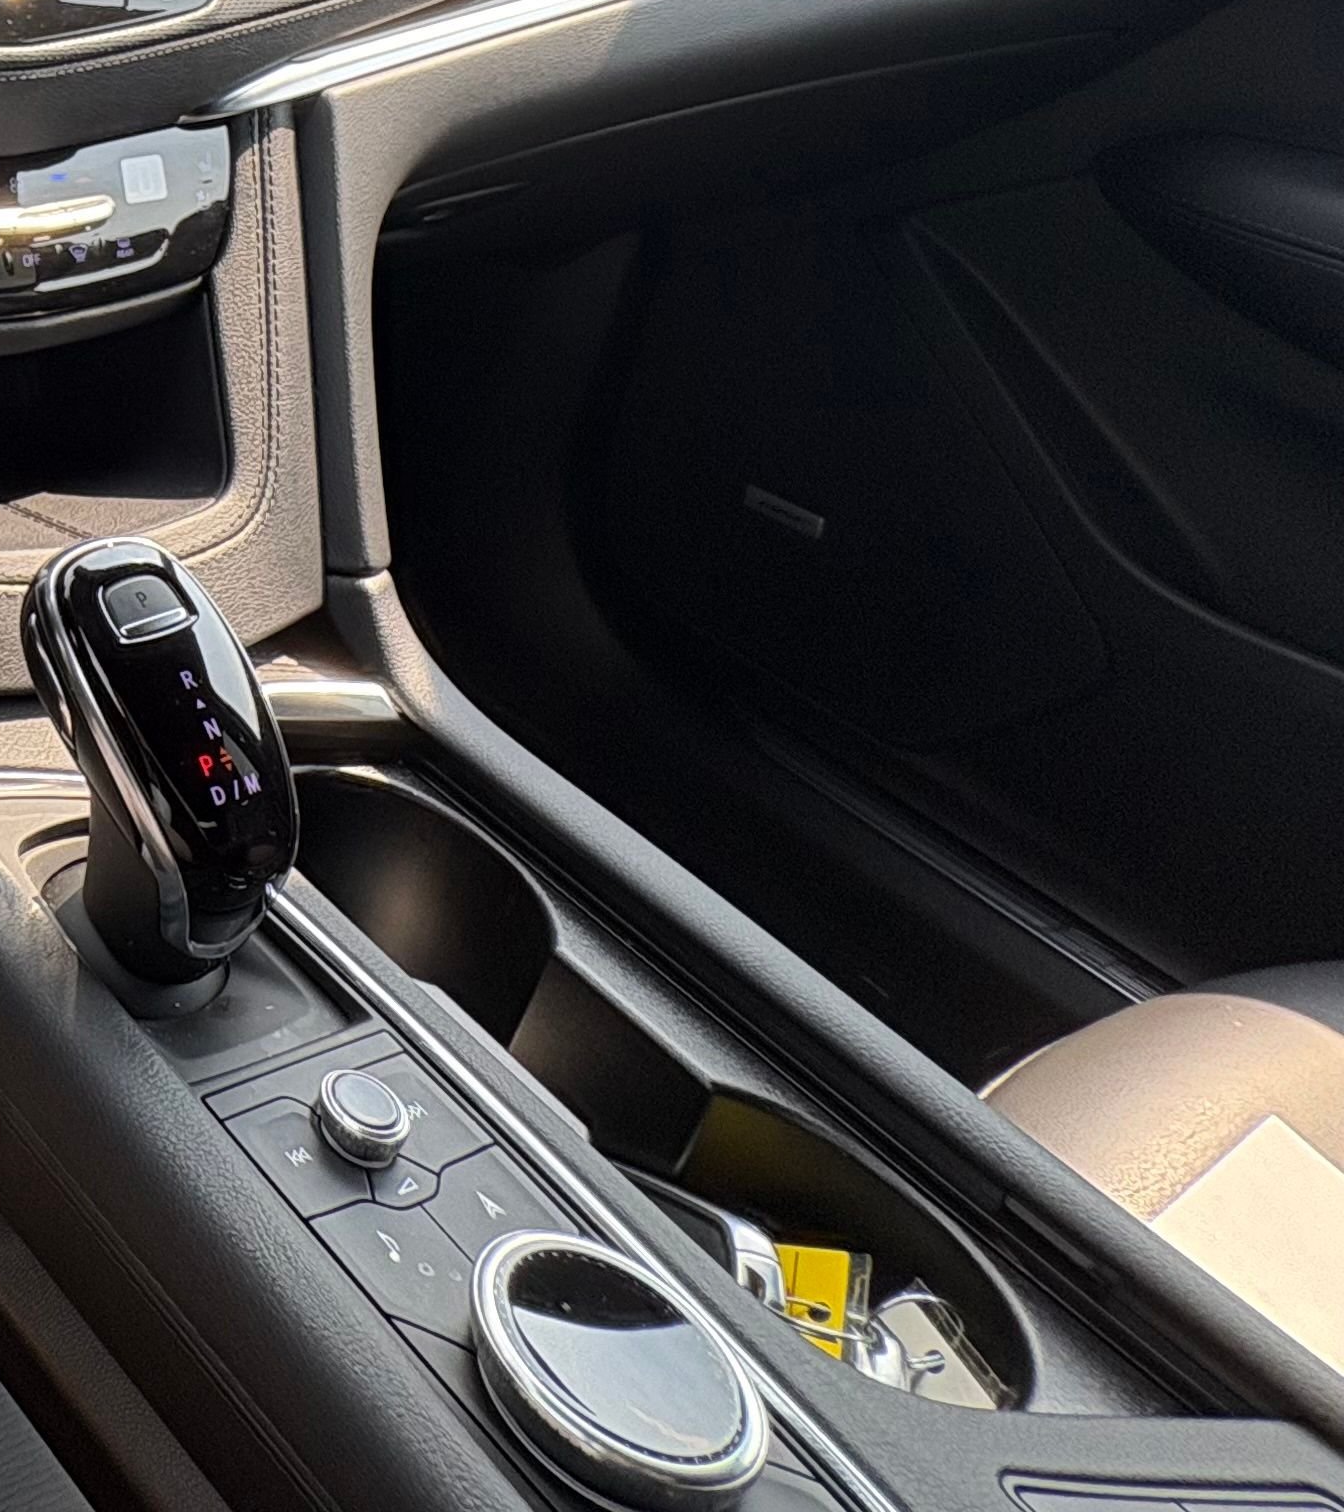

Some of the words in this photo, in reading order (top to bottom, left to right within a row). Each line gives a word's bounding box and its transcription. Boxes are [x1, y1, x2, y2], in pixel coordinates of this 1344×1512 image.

[22, 253, 41, 267] OFF
[135, 591, 148, 609] P
[179, 669, 199, 691] R
[202, 717, 222, 741] N
[197, 754, 214, 777] P
